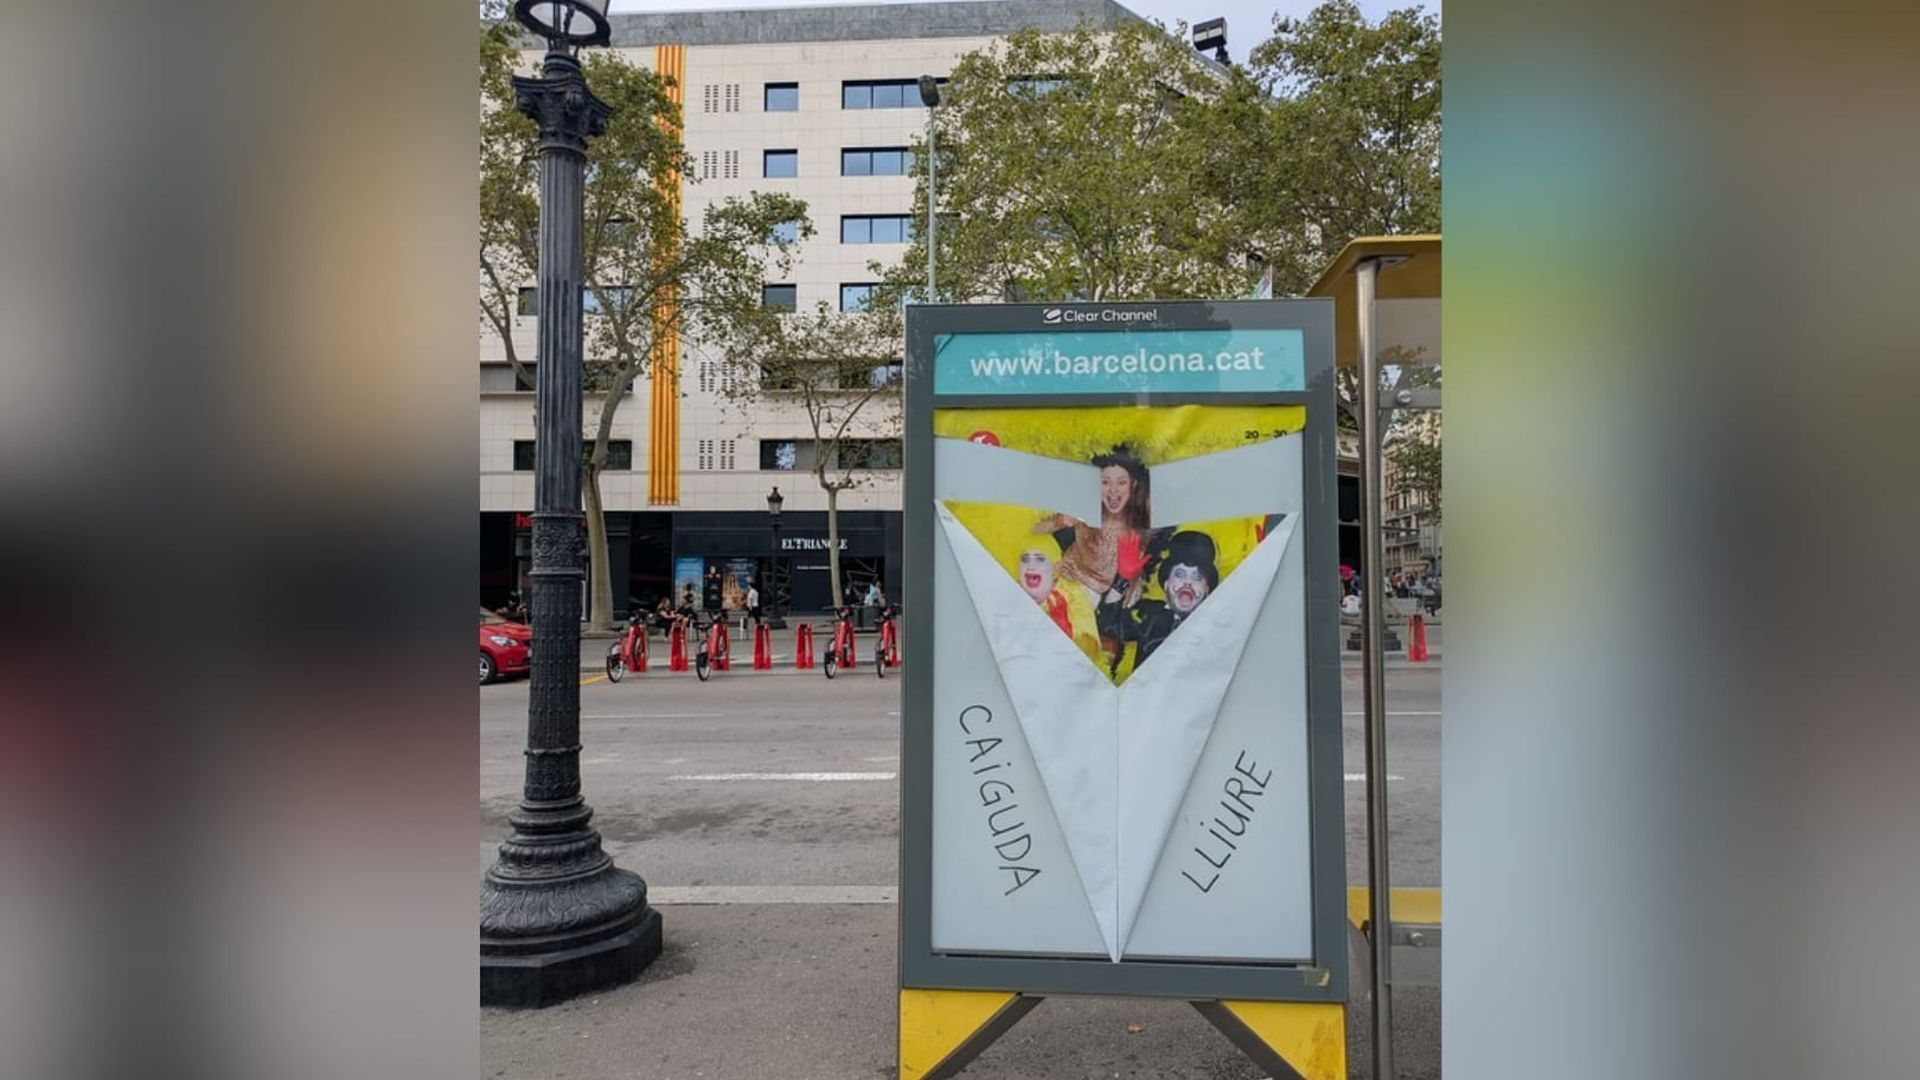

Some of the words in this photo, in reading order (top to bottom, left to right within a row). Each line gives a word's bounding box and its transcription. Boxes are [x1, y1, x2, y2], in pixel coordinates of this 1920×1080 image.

[1063, 310, 1099, 321] Clear
[1101, 309, 1158, 321] Channel
[971, 347, 1264, 376] www.barcelona.cat
[1245, 430, 1260, 440] 20
[793, 538, 848, 550] TRIANE
